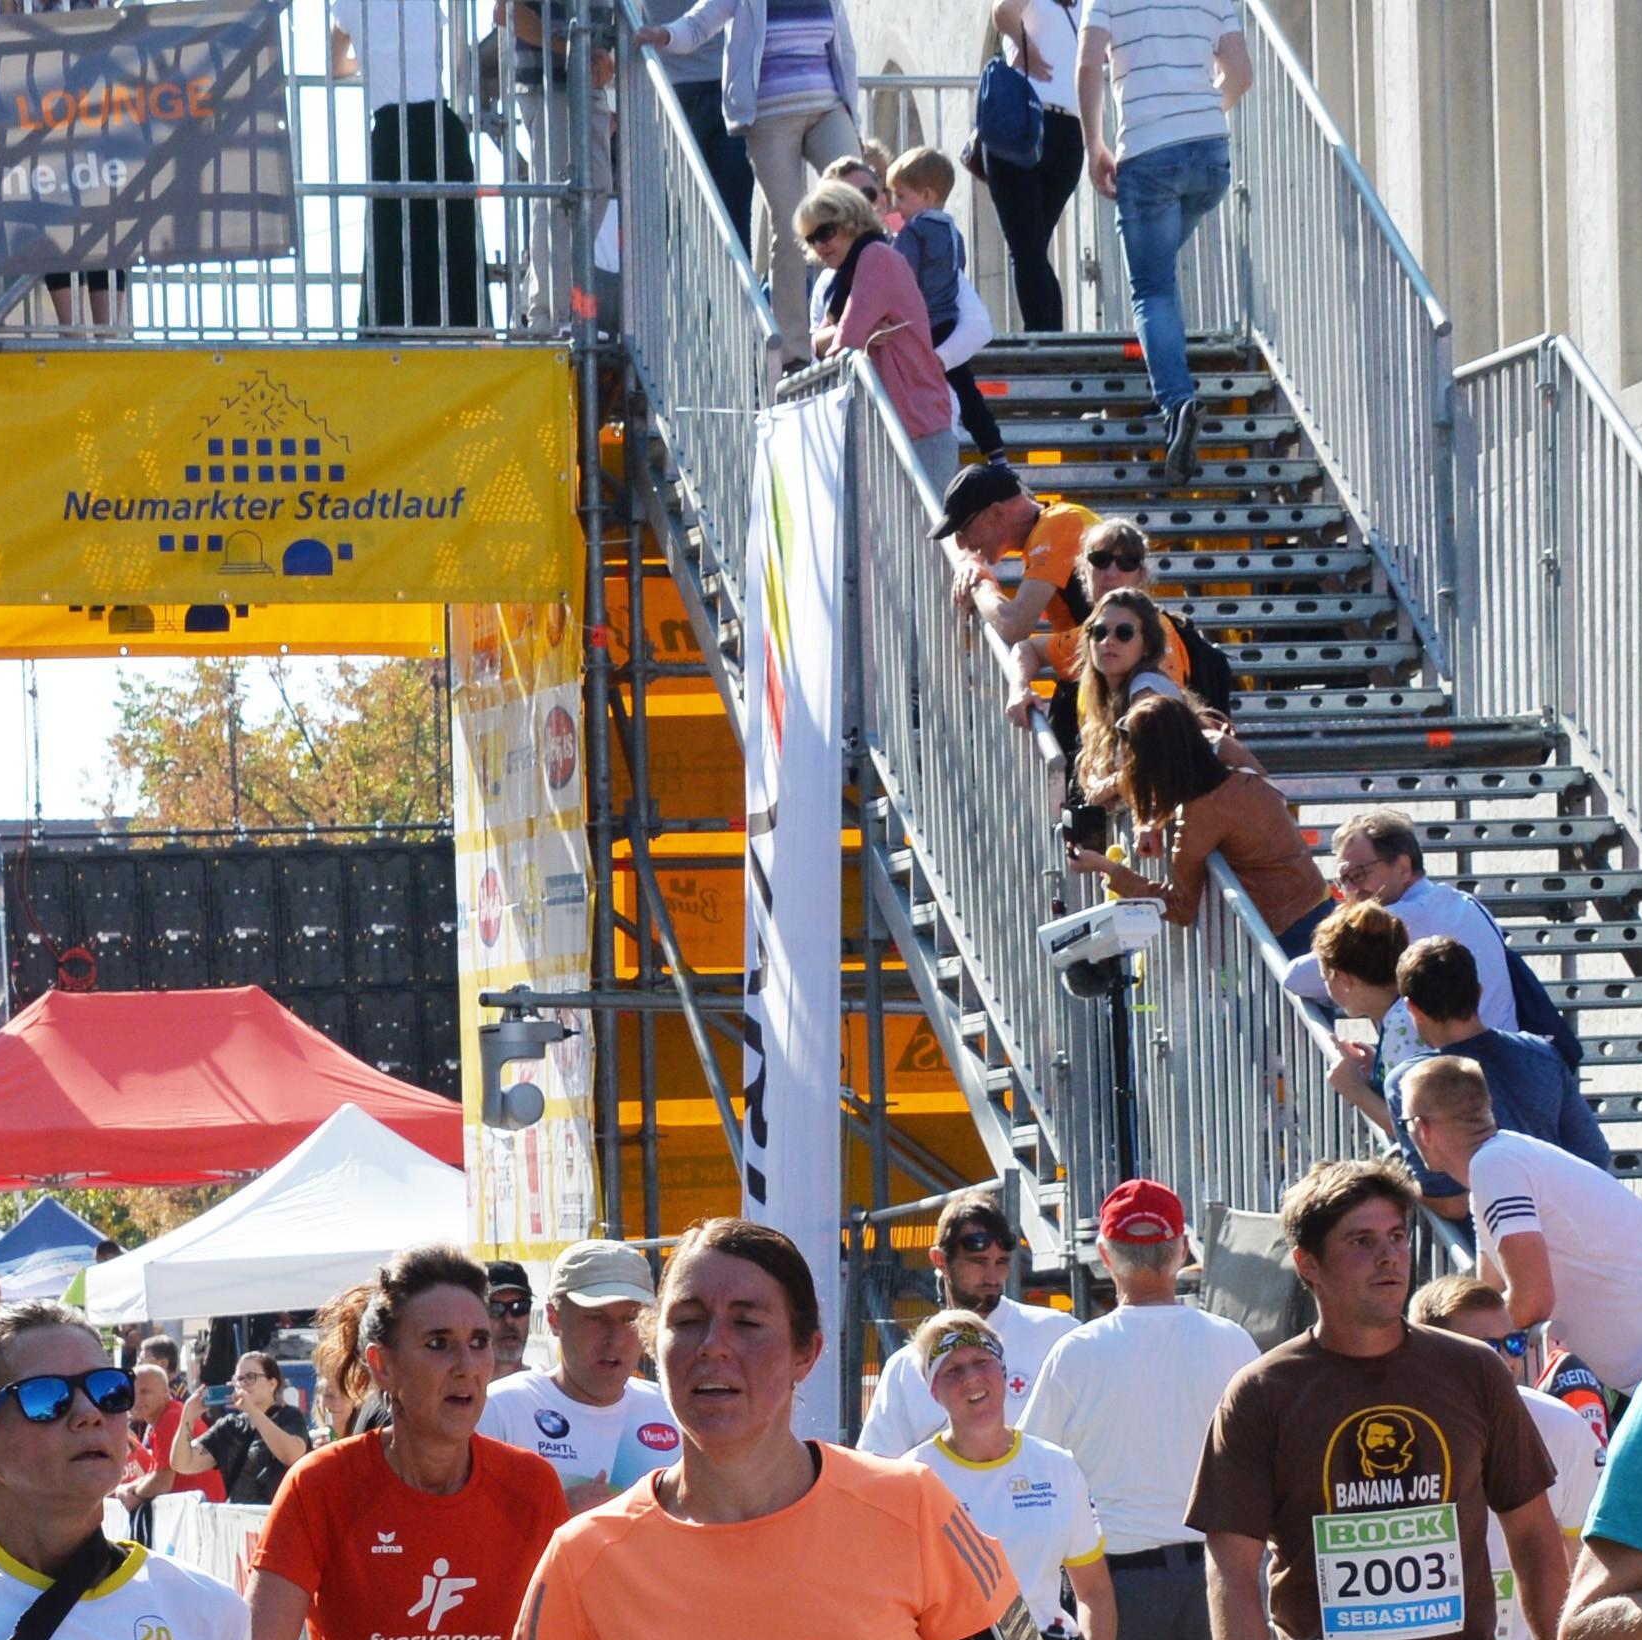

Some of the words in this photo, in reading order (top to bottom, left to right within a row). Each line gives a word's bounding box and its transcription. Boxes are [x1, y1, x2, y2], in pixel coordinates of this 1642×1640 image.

[17, 78, 214, 132] LOUNGE
[63, 486, 282, 524] Neumarkter
[293, 486, 466, 524] Stadtlauf
[537, 1440, 577, 1454] PARTL
[1335, 1479, 1405, 1508] BANANA
[1408, 1474, 1441, 1501] JOE
[1328, 1514, 1444, 1546] BOCK
[370, 1544, 403, 1554] erima
[1335, 1552, 1447, 1598] 2003
[1336, 1601, 1452, 1627] SEBASTIAN
